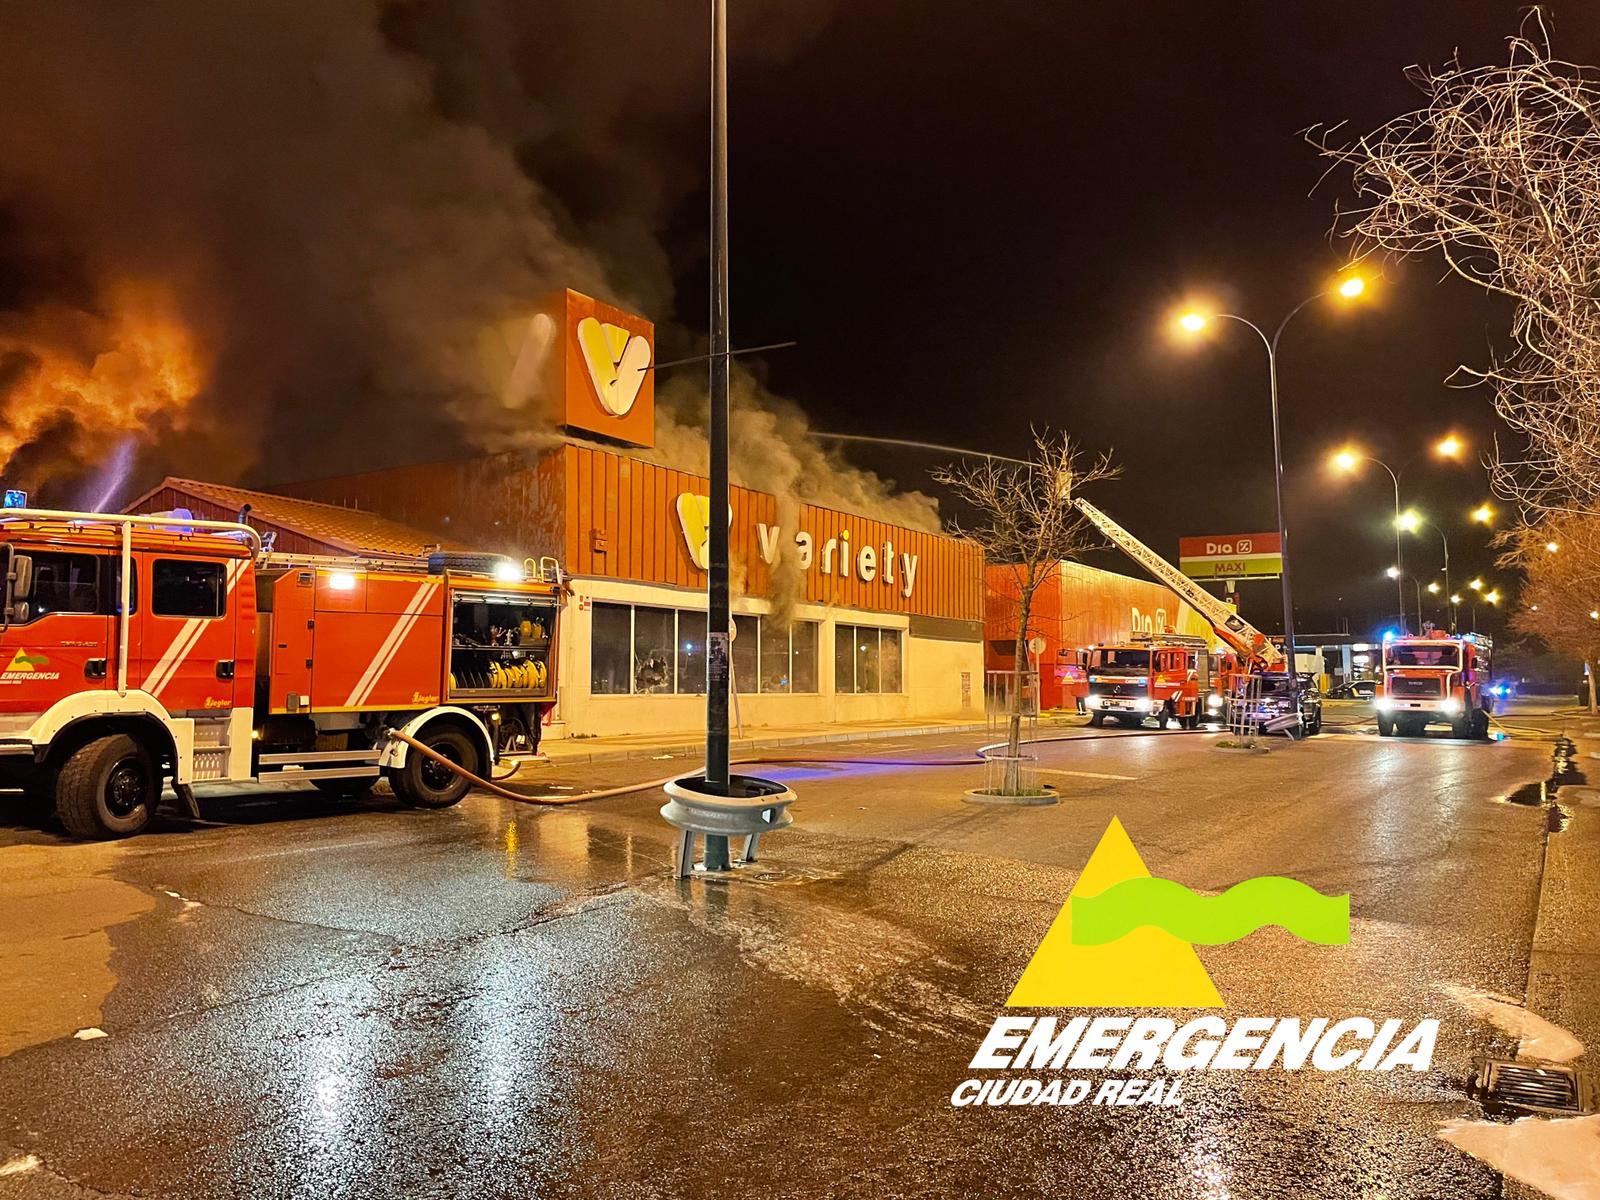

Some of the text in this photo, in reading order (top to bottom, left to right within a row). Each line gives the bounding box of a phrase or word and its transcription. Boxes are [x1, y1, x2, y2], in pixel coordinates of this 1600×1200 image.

[756, 522, 919, 598] variety
[1215, 562, 1246, 572] MAXI
[1, 672, 60, 680] EMERGENCIA
